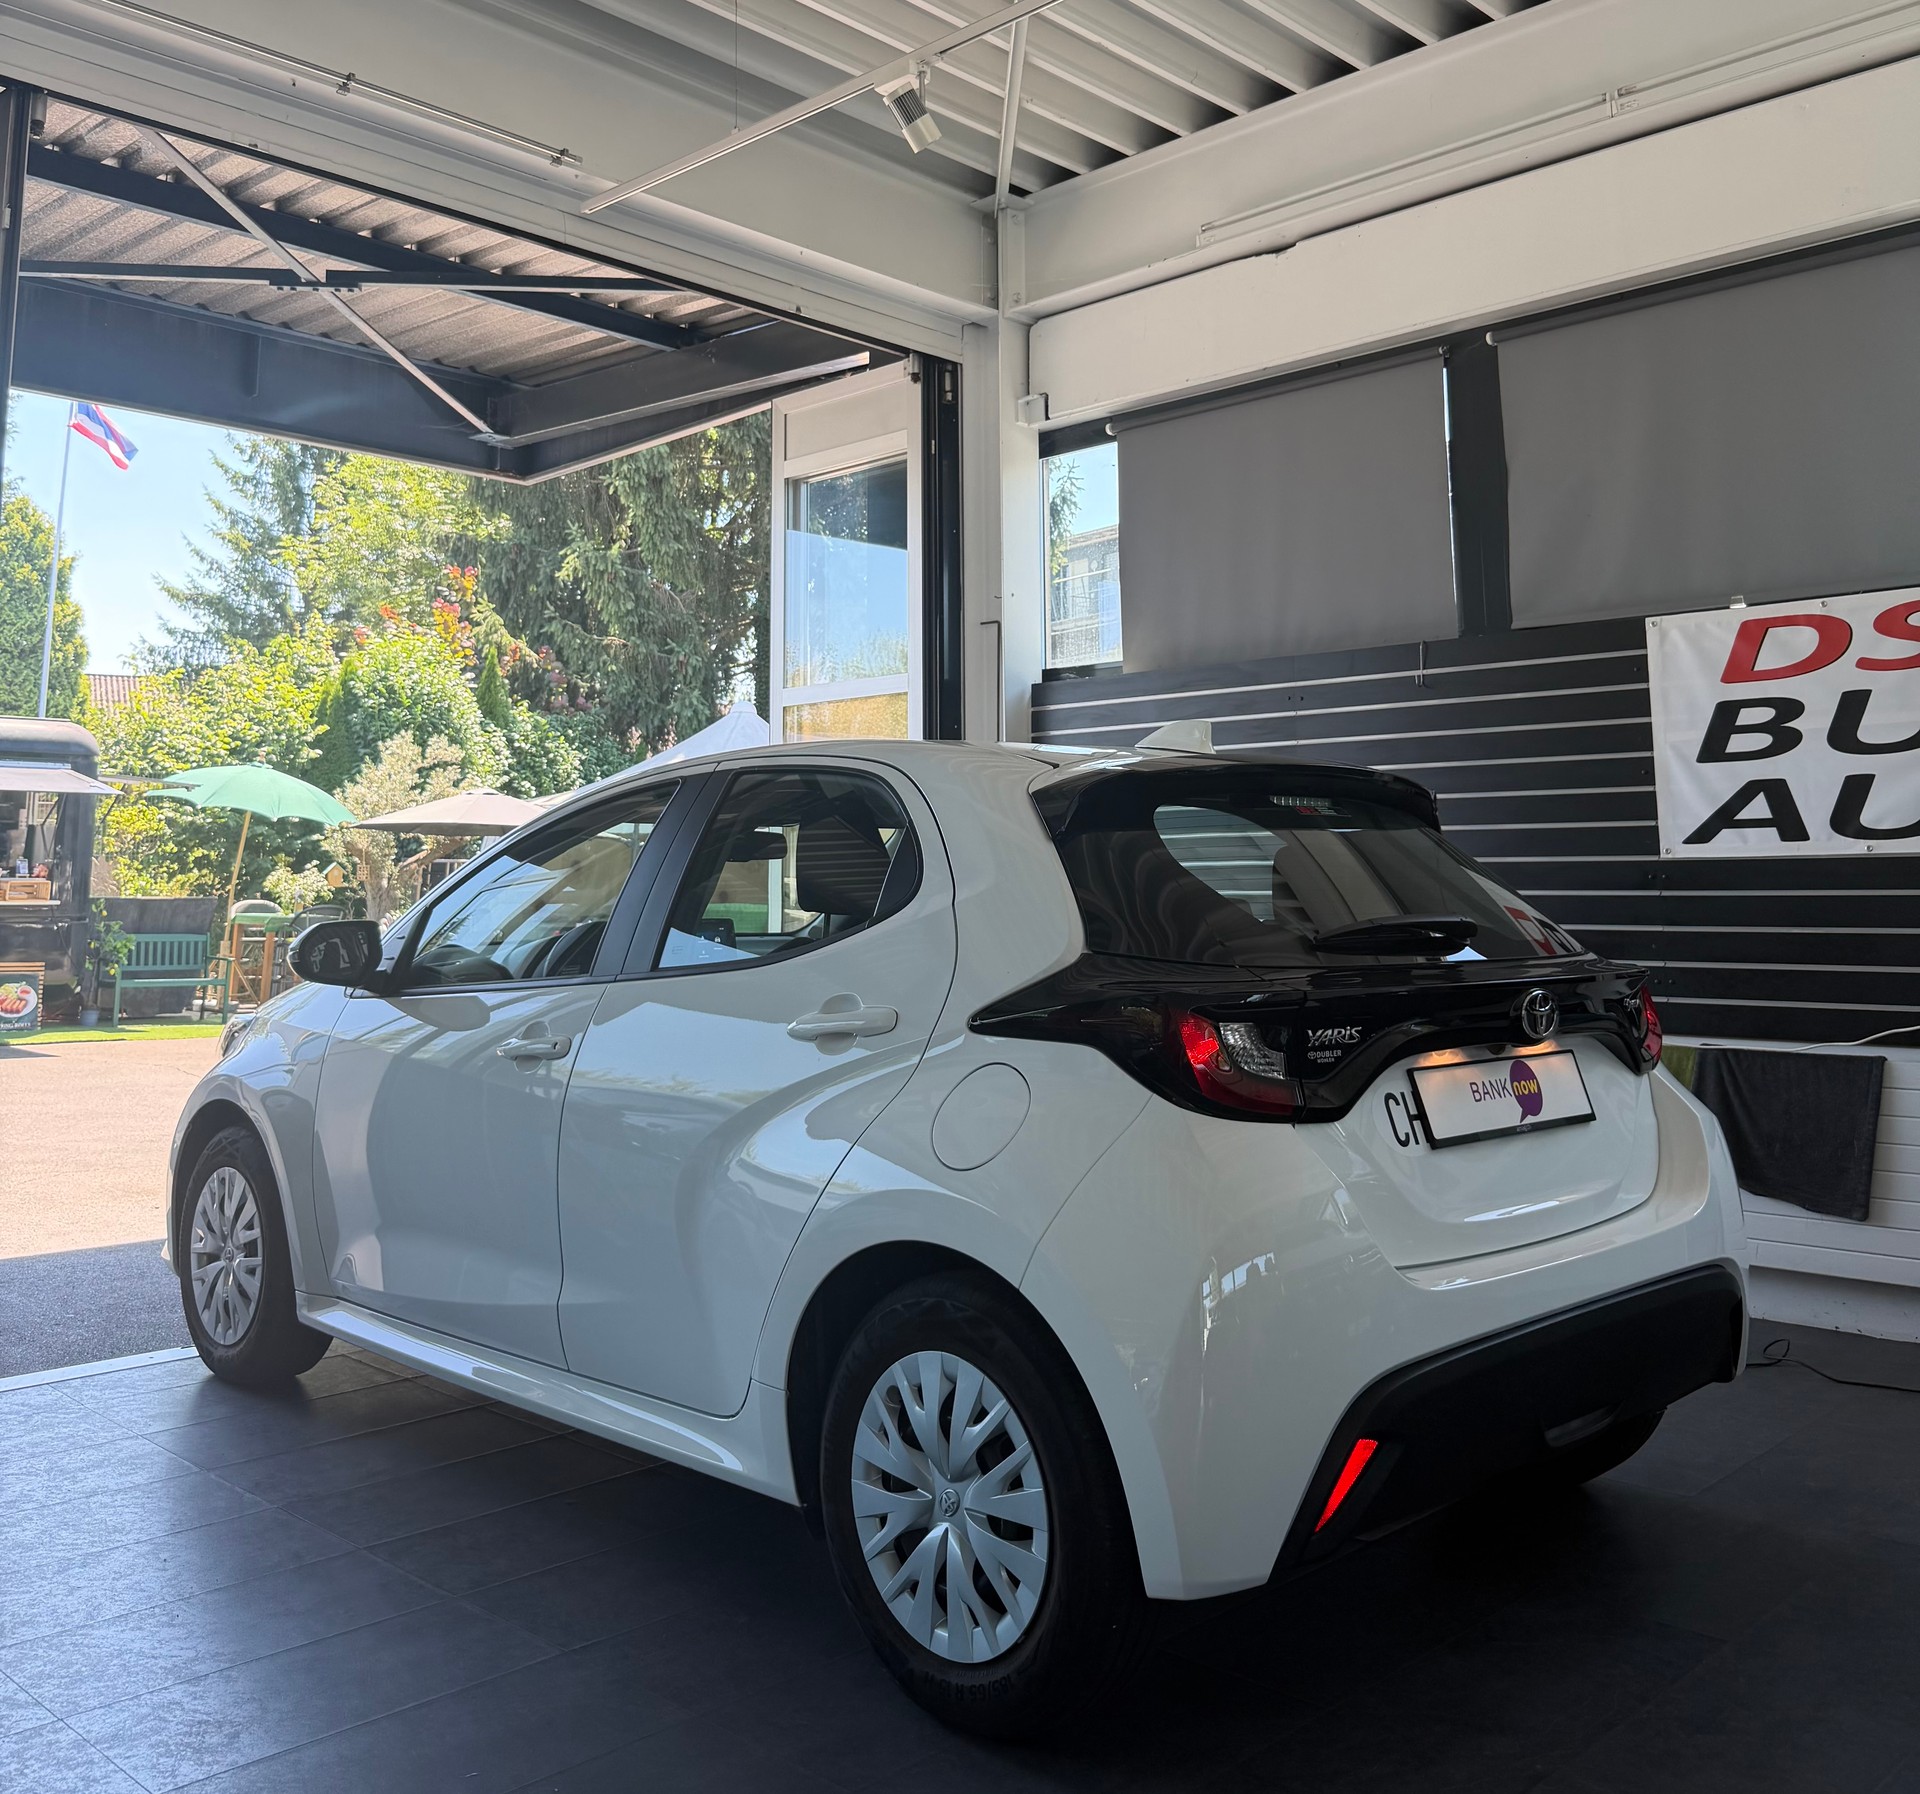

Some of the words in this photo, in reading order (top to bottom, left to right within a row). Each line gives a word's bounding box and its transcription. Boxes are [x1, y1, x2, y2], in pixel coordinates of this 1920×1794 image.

[1696, 689, 1920, 763] BU
[1682, 774, 1920, 844] AU
[1306, 1026, 1362, 1047] YARIS
[1316, 1049, 1342, 1059] DUBLER
[1469, 1078, 1512, 1102] BANK
[1513, 1079, 1537, 1096] now
[1384, 1090, 1422, 1147] CH
